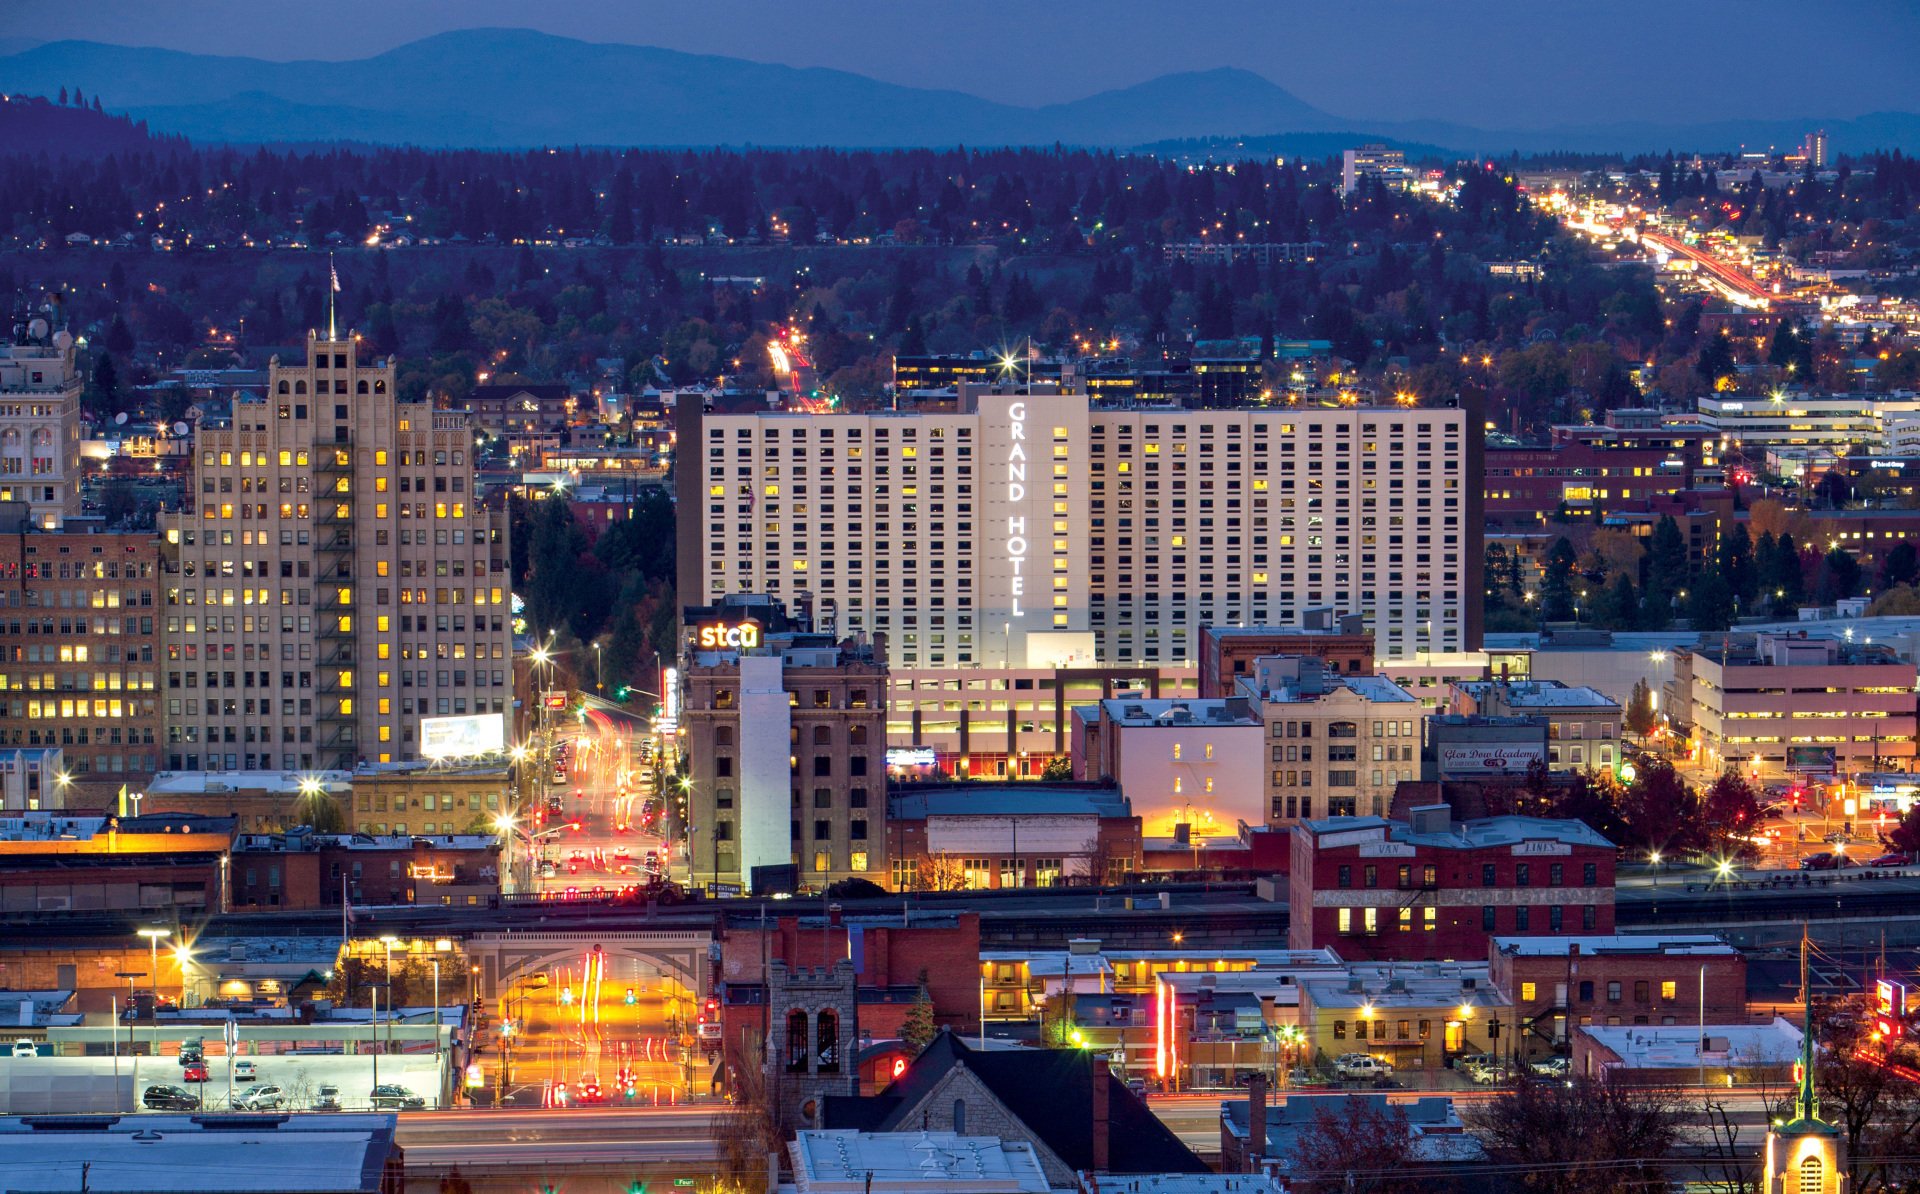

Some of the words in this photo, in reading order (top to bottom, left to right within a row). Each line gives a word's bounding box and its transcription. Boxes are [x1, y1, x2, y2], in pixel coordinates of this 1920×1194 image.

[1008, 402, 1026, 502] GRAND
[1007, 516, 1027, 617] HOTEL
[701, 622, 758, 648] stcu
[1445, 749, 1466, 760] Glen
[1469, 749, 1492, 759] Dow
[1494, 748, 1539, 760] Academy
[1379, 844, 1400, 854] VAN
[1525, 842, 1556, 852] LINES
